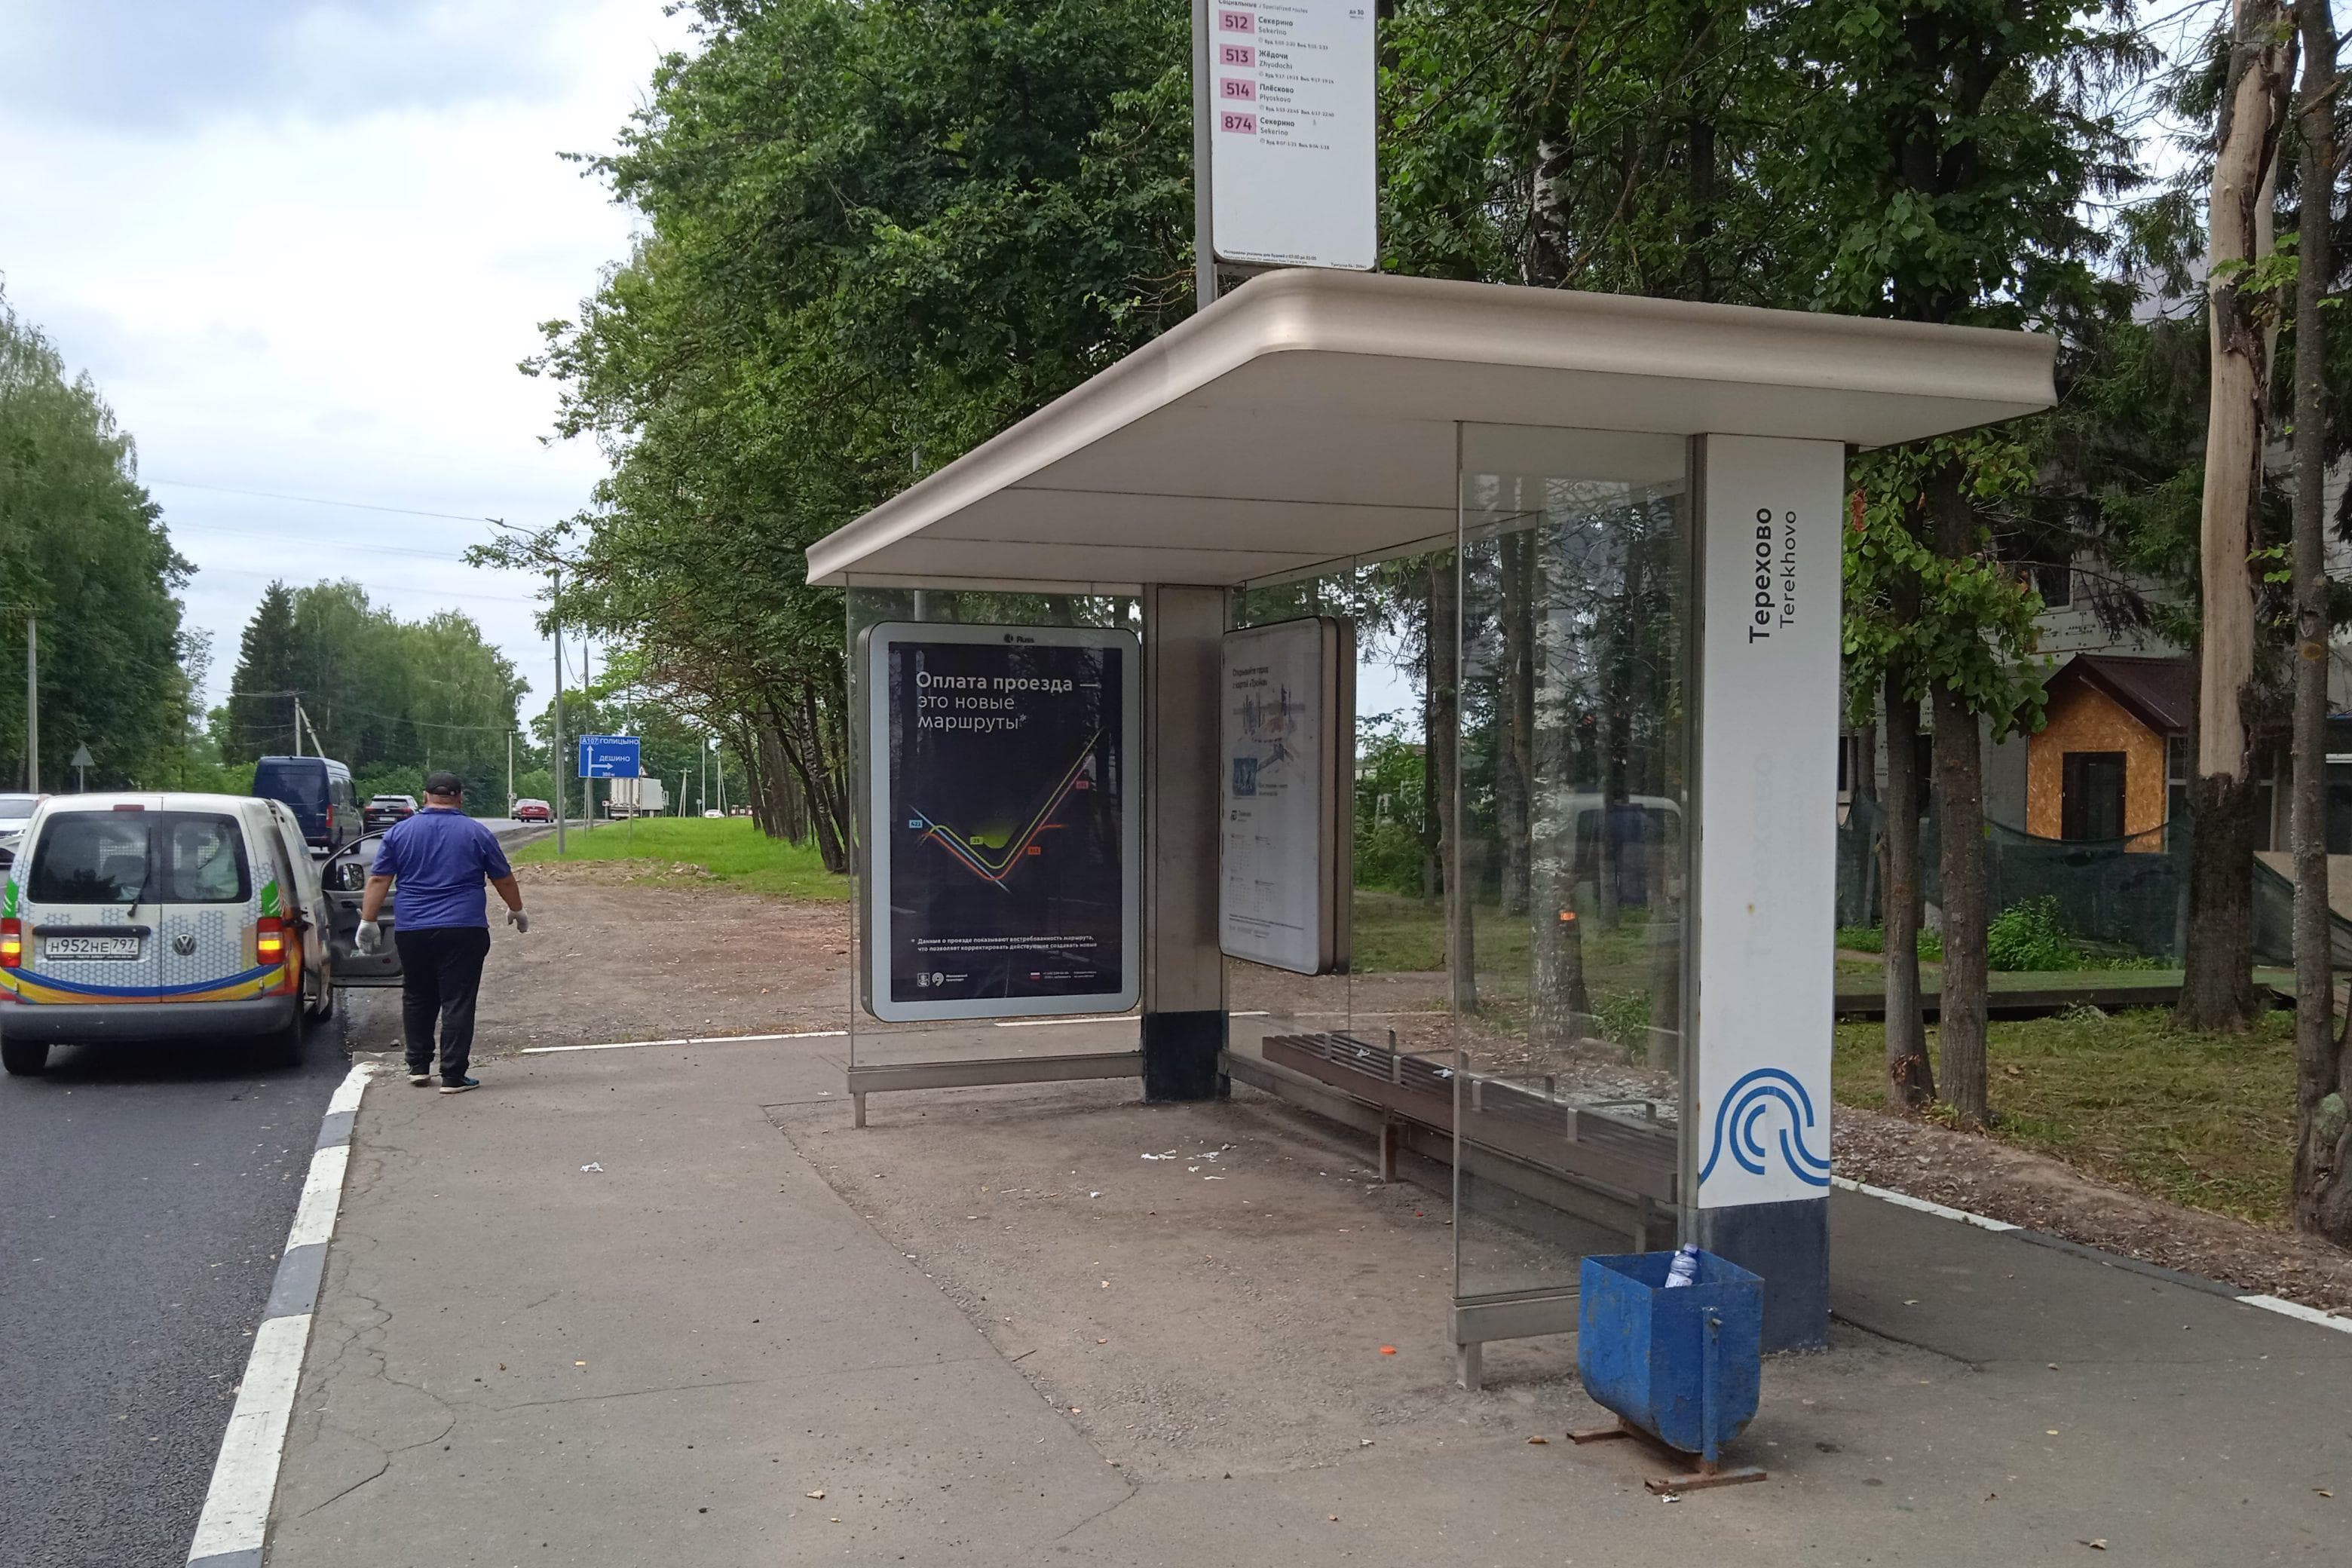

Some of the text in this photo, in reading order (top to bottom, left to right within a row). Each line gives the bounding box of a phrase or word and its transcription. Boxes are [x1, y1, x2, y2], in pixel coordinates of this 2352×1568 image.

[1225, 14, 1248, 29] 512
[1258, 16, 1294, 26] Секерино
[1226, 49, 1248, 63] 513
[1259, 50, 1288, 60] Жёдочи
[1227, 82, 1249, 96] 514
[1260, 83, 1294, 93] Плёсково
[1260, 93, 1291, 103] Plyoskovo
[1225, 115, 1252, 130] 874
[1260, 117, 1295, 127] Секерино
[1260, 127, 1288, 136] Sekerino
[1749, 508, 1775, 644] Терехово
[1780, 511, 1796, 629] Terekhovo
[916, 671, 988, 689] Оплата
[994, 677, 1073, 694] проезда
[917, 696, 1015, 709] это новые
[51, 939, 135, 953] Н952НЕ 797
